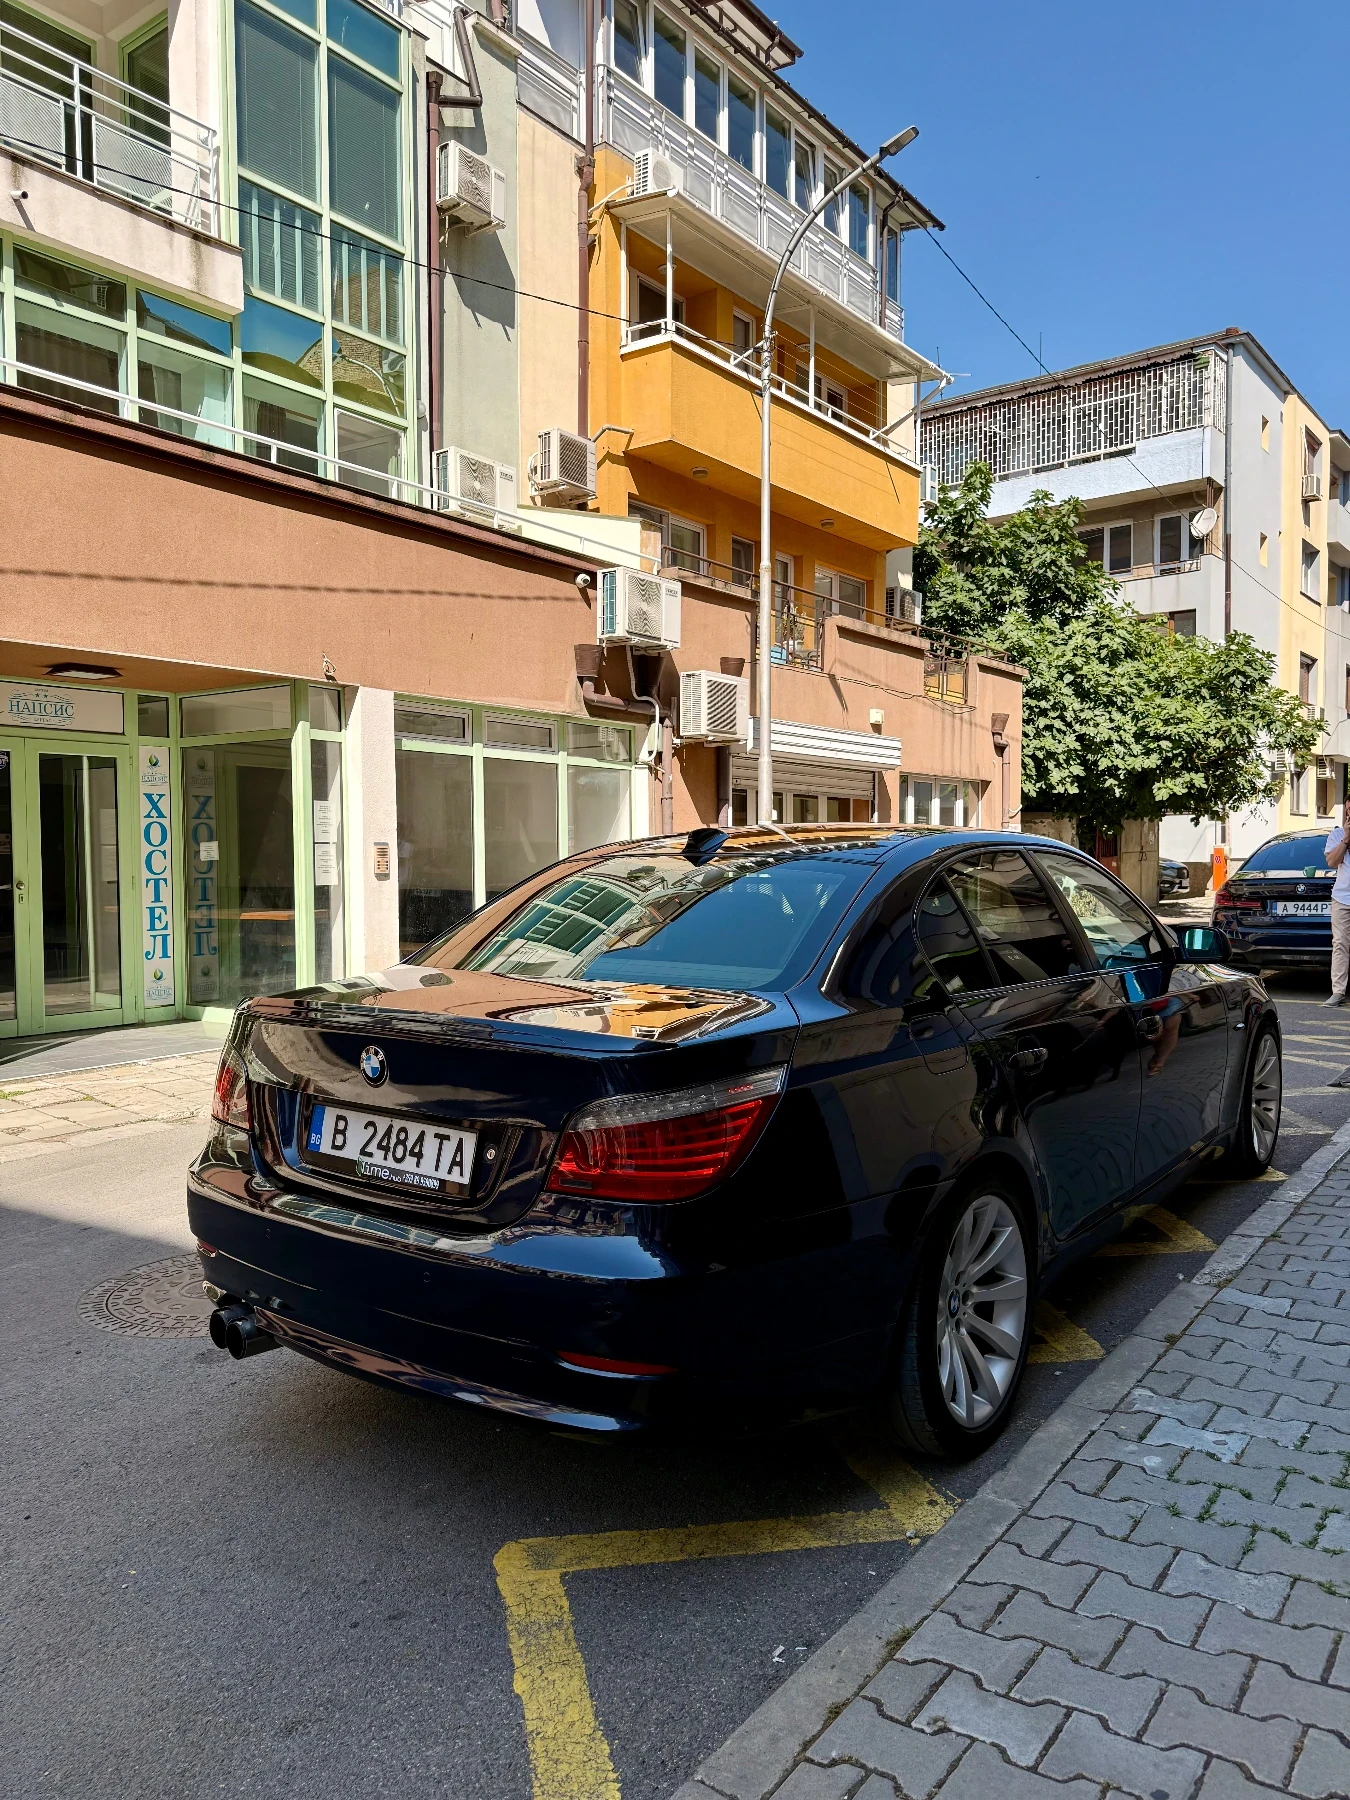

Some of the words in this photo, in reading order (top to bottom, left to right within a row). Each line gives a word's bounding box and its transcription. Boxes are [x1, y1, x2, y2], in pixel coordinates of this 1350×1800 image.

[142, 792, 172, 961] ХОСТЕЛ
[1293, 903, 1319, 913] 9444
[310, 1132, 321, 1145] BG
[359, 1120, 426, 1169] 2484
